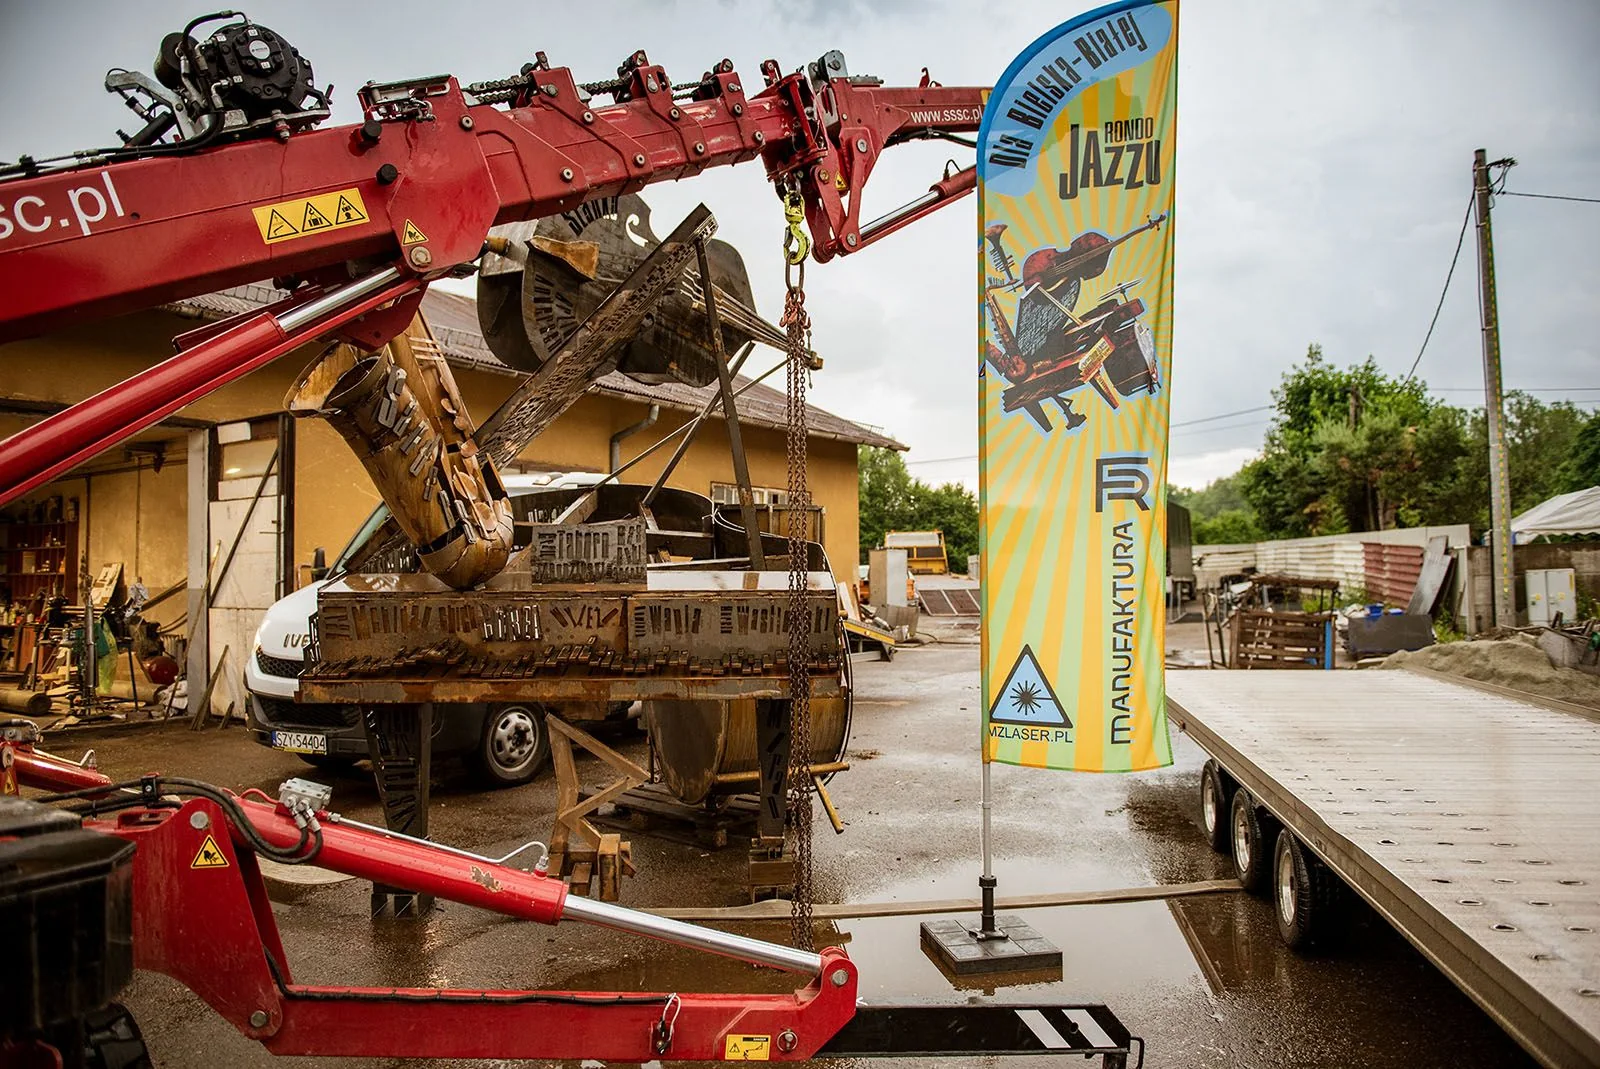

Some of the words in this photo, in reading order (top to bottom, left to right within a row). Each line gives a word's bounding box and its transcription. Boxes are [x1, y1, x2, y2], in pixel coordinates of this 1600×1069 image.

[1006, 11, 1149, 131] Bielska-Białej
[911, 105, 983, 124] www.sssc.pl
[1104, 117, 1154, 144] RONDO
[989, 134, 1034, 169] Dla
[1059, 123, 1161, 200] JAZZU
[1110, 521, 1134, 744] MANUFAKTURA
[277, 732, 293, 747] SZY
[296, 734, 326, 750] 54404
[989, 726, 1073, 743] MZLASER.PL
